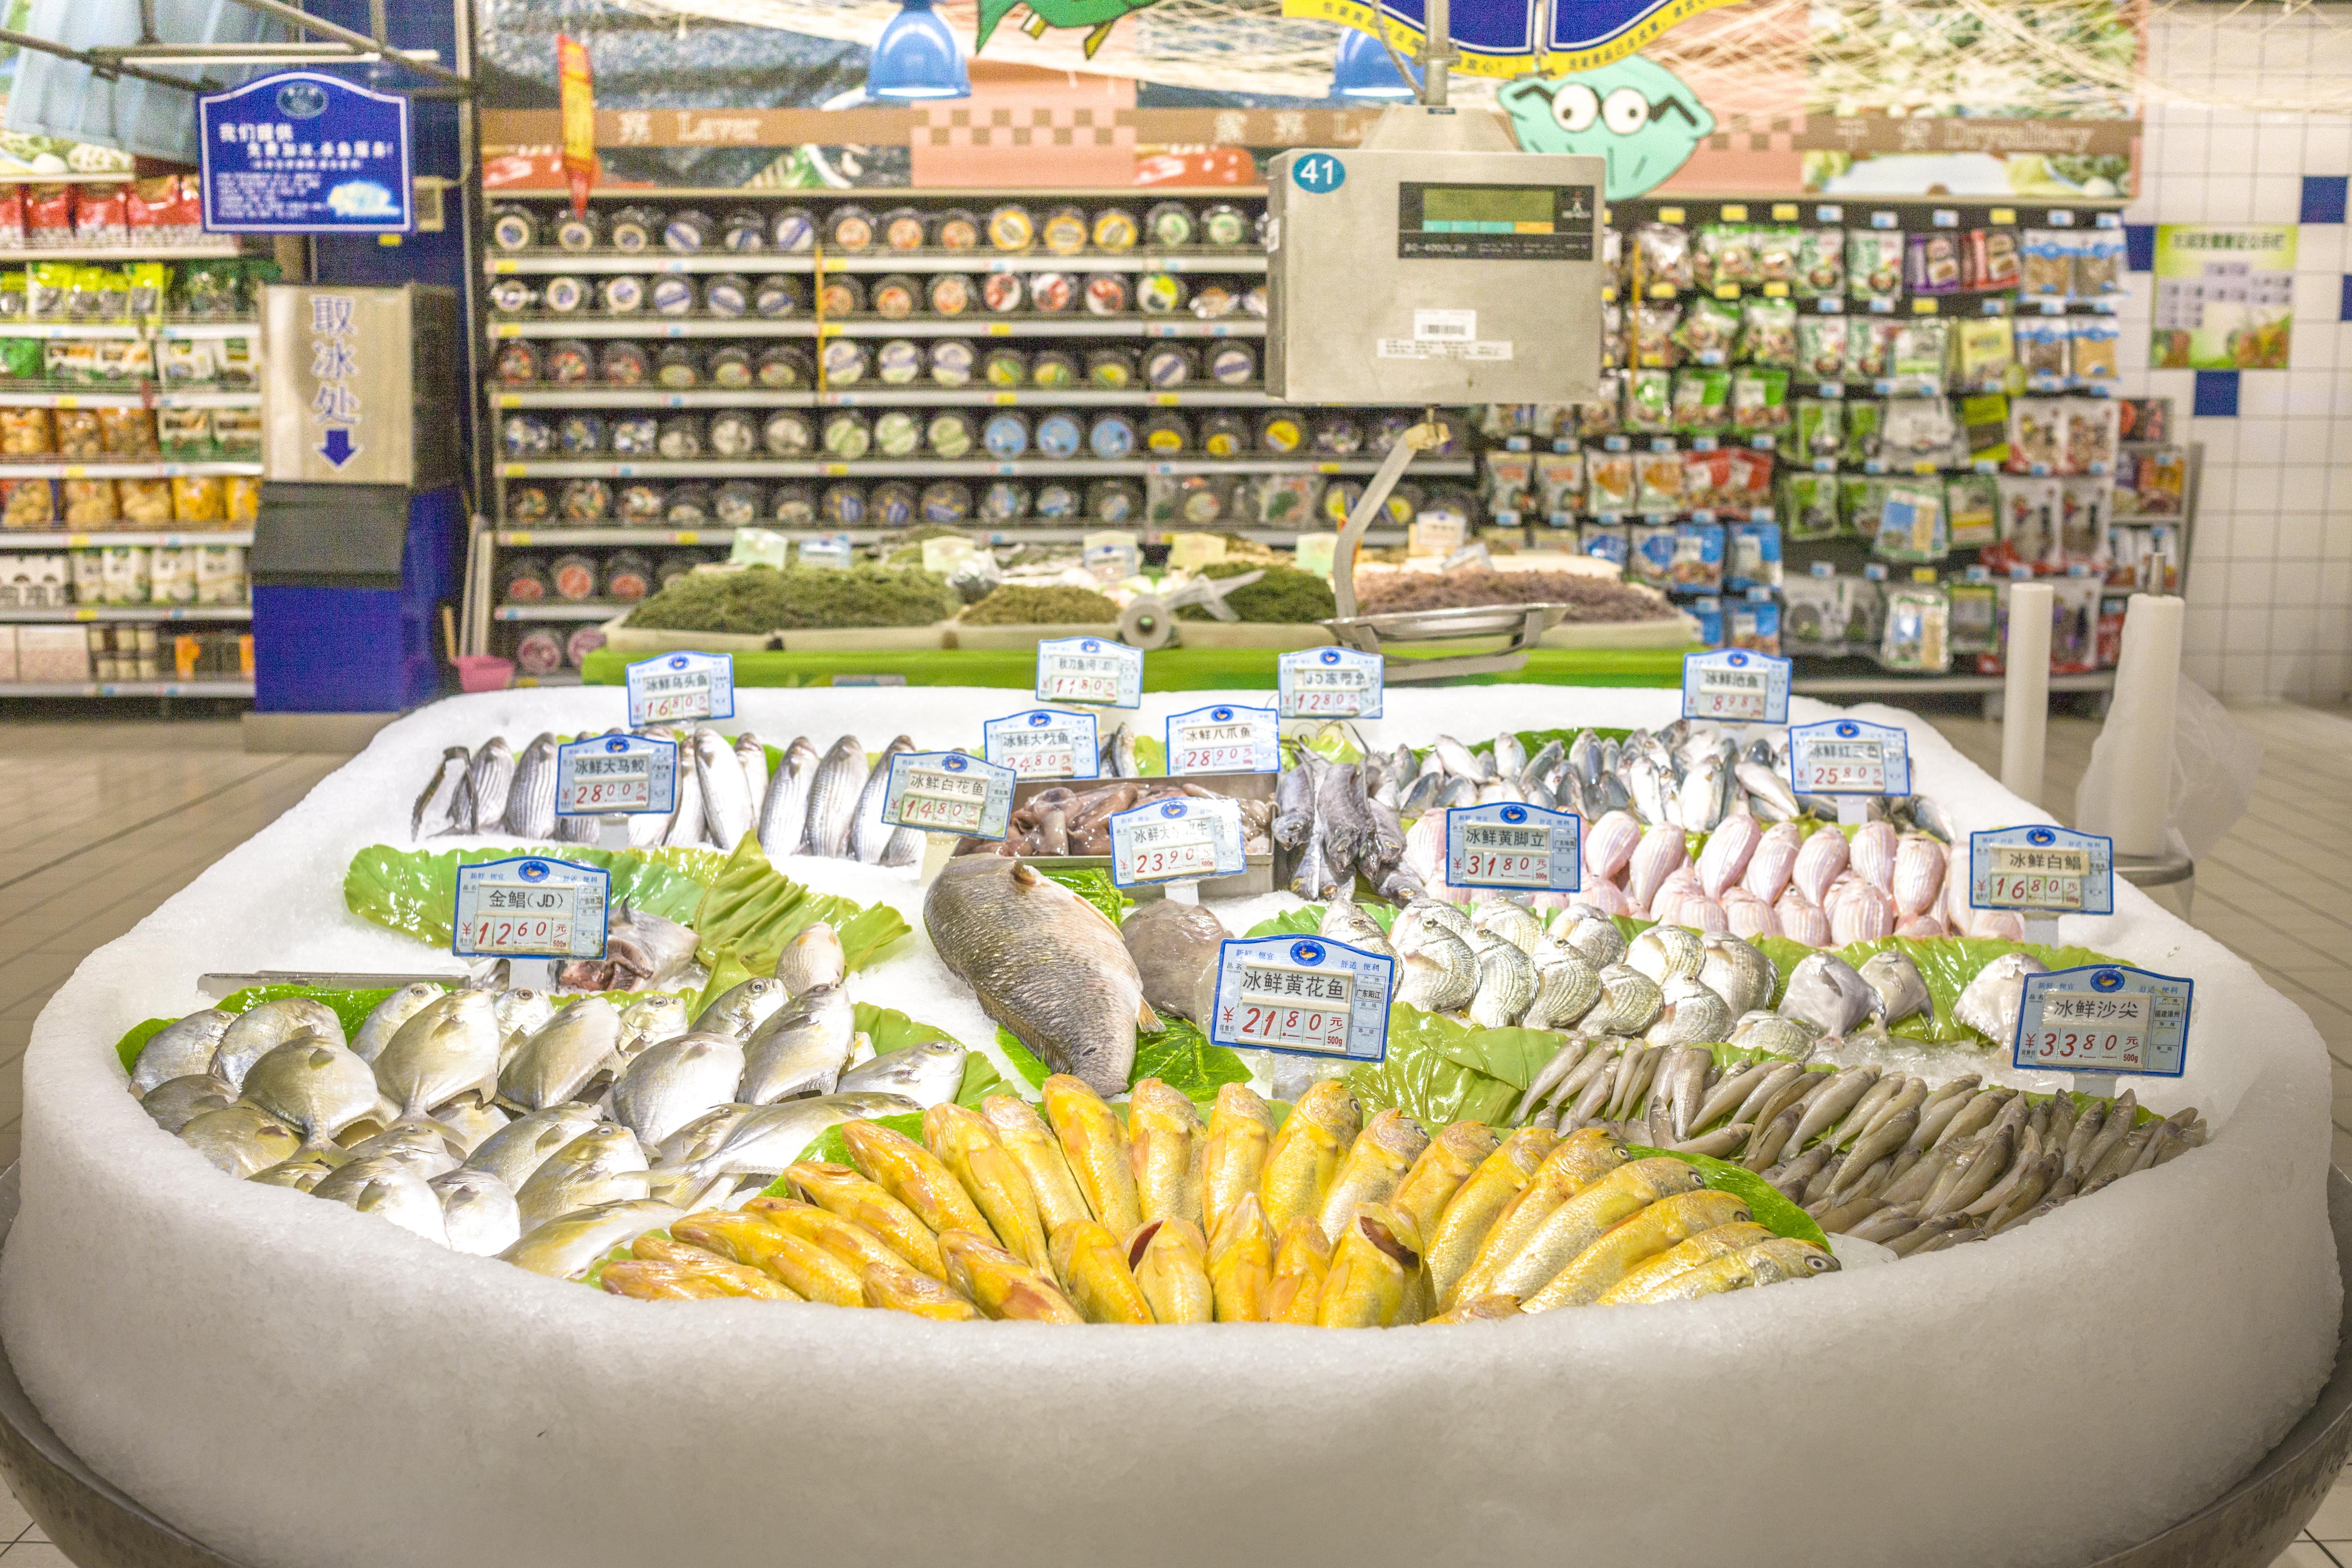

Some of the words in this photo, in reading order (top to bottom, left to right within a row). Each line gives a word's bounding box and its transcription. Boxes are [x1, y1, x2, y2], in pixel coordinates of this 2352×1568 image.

[677, 112, 763, 142] Laver
[1300, 159, 1334, 185] 41
[310, 295, 361, 424] 取冰处
[1187, 727, 1251, 742] 冰鲜八爪鱼
[575, 759, 645, 774] 冰鲜大马鲛
[910, 774, 984, 796] 冰鲜白花鱼
[1135, 822, 1207, 842] 冰鲜大牛
[1466, 829, 1545, 847] 冰鲜黄脚立
[1136, 848, 1194, 873] 23.90
[1467, 855, 1529, 877] 31.80
[2010, 853, 2081, 870] 冰鲜白鲳
[478, 922, 547, 945] 12.60
[1259, 951, 1274, 960] 便宜
[1341, 960, 1357, 969] 舒适
[1363, 963, 1379, 971] 便利
[1243, 971, 1344, 999] 冰鲜黄花鱼
[1356, 989, 1381, 999] 广东阳江
[2054, 1000, 2139, 1018] 冰鲜沙尖
[1242, 1008, 1322, 1037] 21.80
[1327, 1036, 1342, 1047] 500g
[2040, 1033, 2117, 1058] 33.80
[2123, 1054, 2138, 1063] 500g
